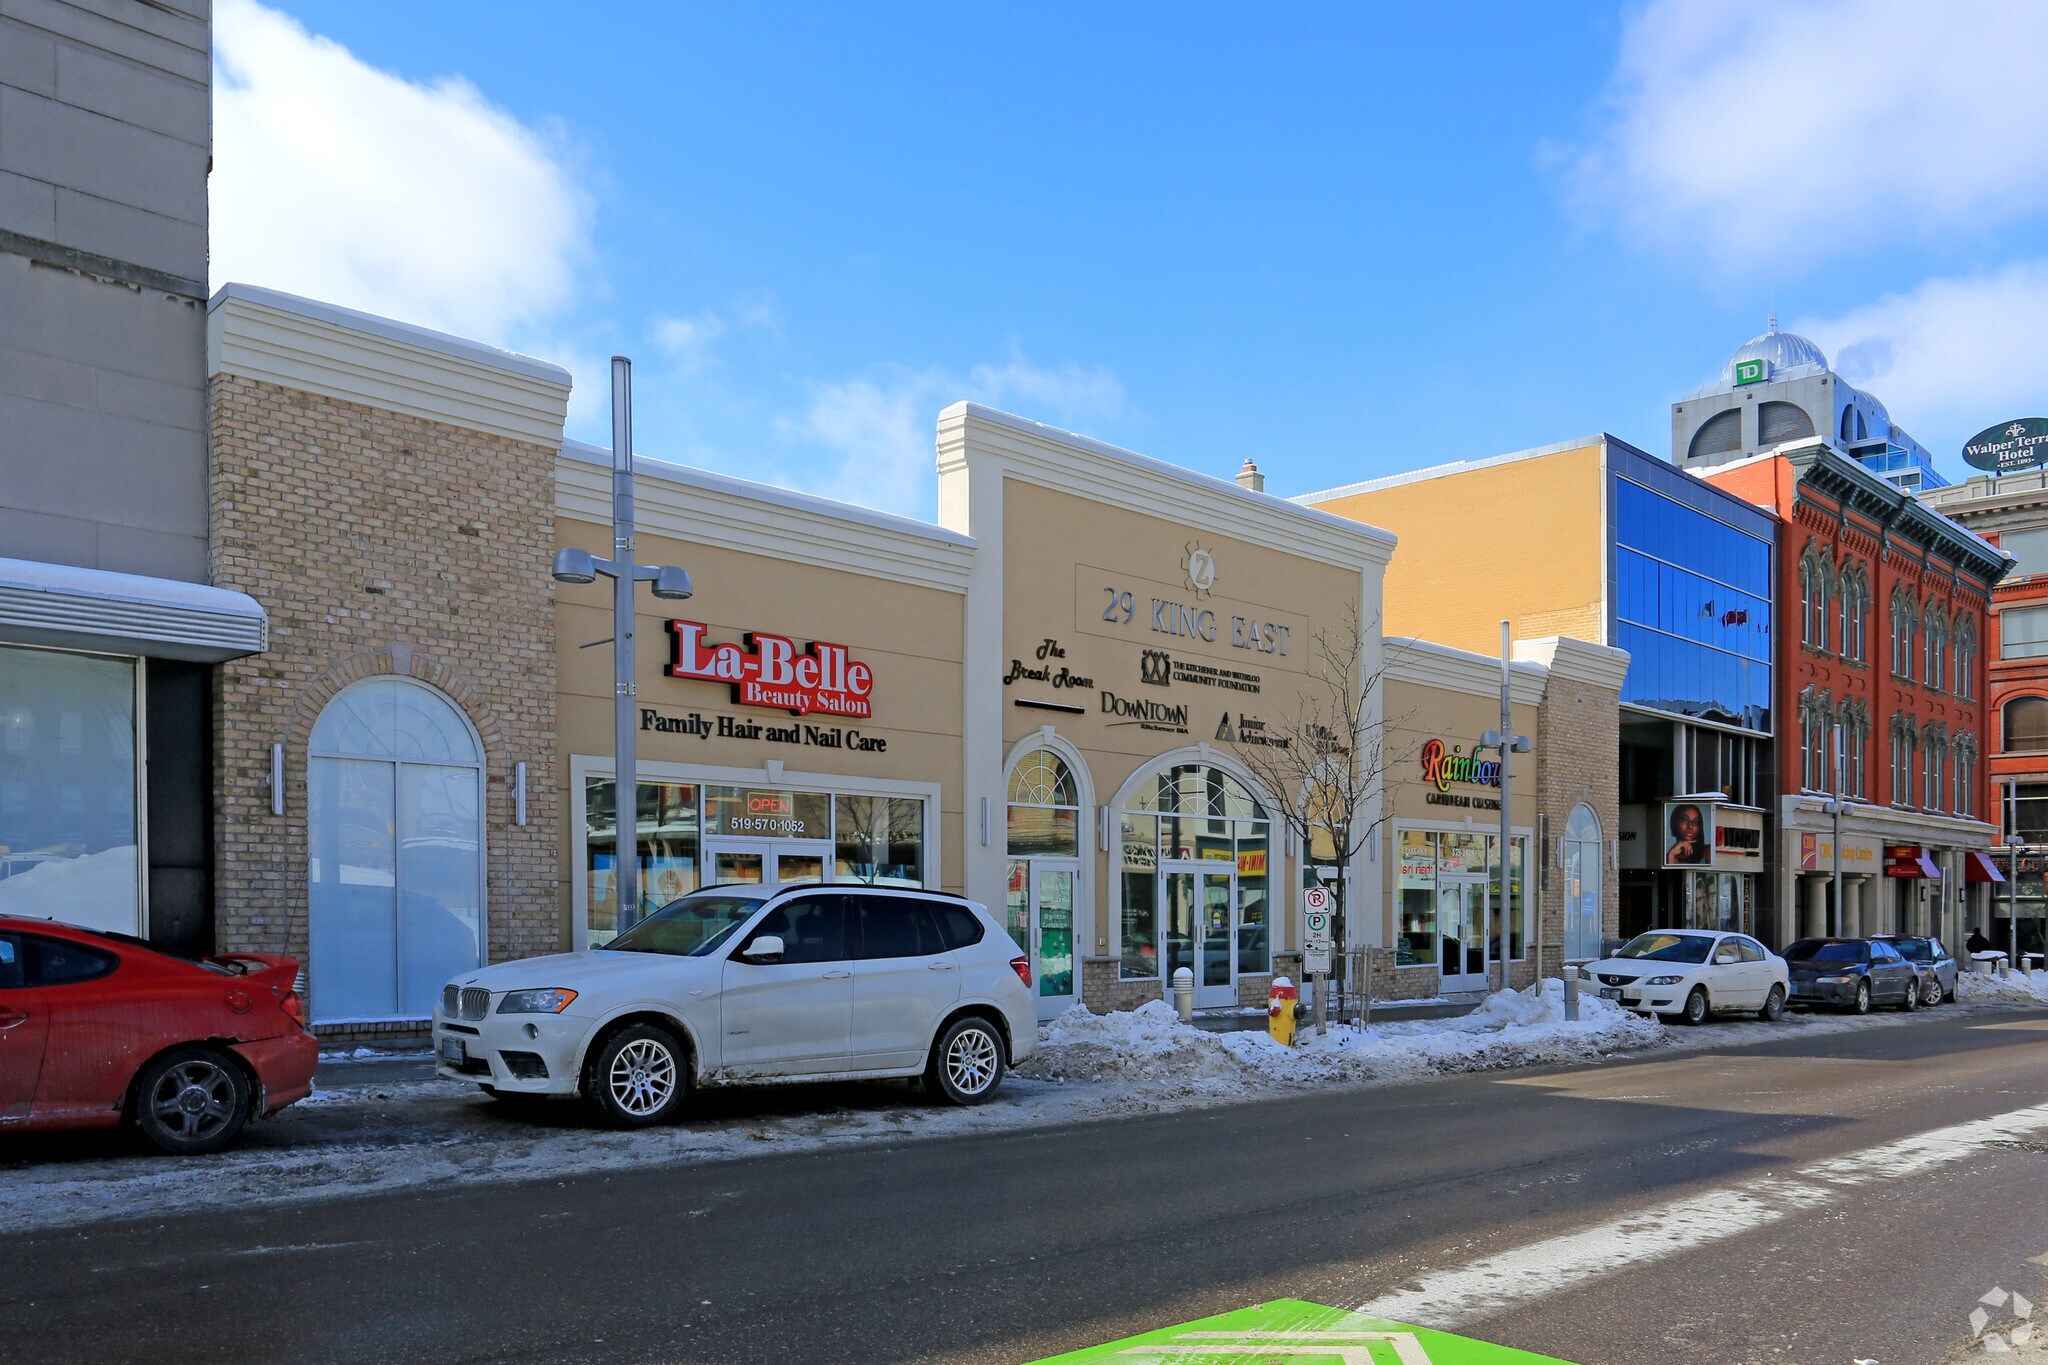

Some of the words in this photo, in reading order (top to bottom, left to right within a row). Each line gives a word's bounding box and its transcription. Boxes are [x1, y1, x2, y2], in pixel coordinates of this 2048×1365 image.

[1738, 363, 1760, 379] TD
[1966, 441, 2015, 456] Walper
[1998, 446, 2034, 462] Hotel
[1194, 553, 1210, 586] Z
[1103, 587, 1136, 625] 29
[1151, 597, 1217, 643] KING
[1231, 615, 1291, 656] EAST
[676, 623, 870, 695] La-Belle
[1036, 638, 1066, 660] The
[1003, 659, 1051, 685] Break
[1052, 667, 1094, 689] Room
[1173, 661, 1186, 670] THE
[1186, 663, 1218, 676] KITCHENER
[1219, 669, 1232, 678] AND
[1173, 671, 1217, 687] COMMUNITY
[1218, 679, 1261, 694] FOUNDATION
[746, 682, 812, 713] Beauty
[816, 691, 868, 714] Salon
[640, 708, 713, 740] Family
[717, 715, 763, 740] Hair
[766, 723, 801, 744] and
[804, 725, 842, 748] Nail
[845, 730, 887, 752] Care
[1238, 713, 1265, 730] Junior
[749, 797, 791, 813] OPEN
